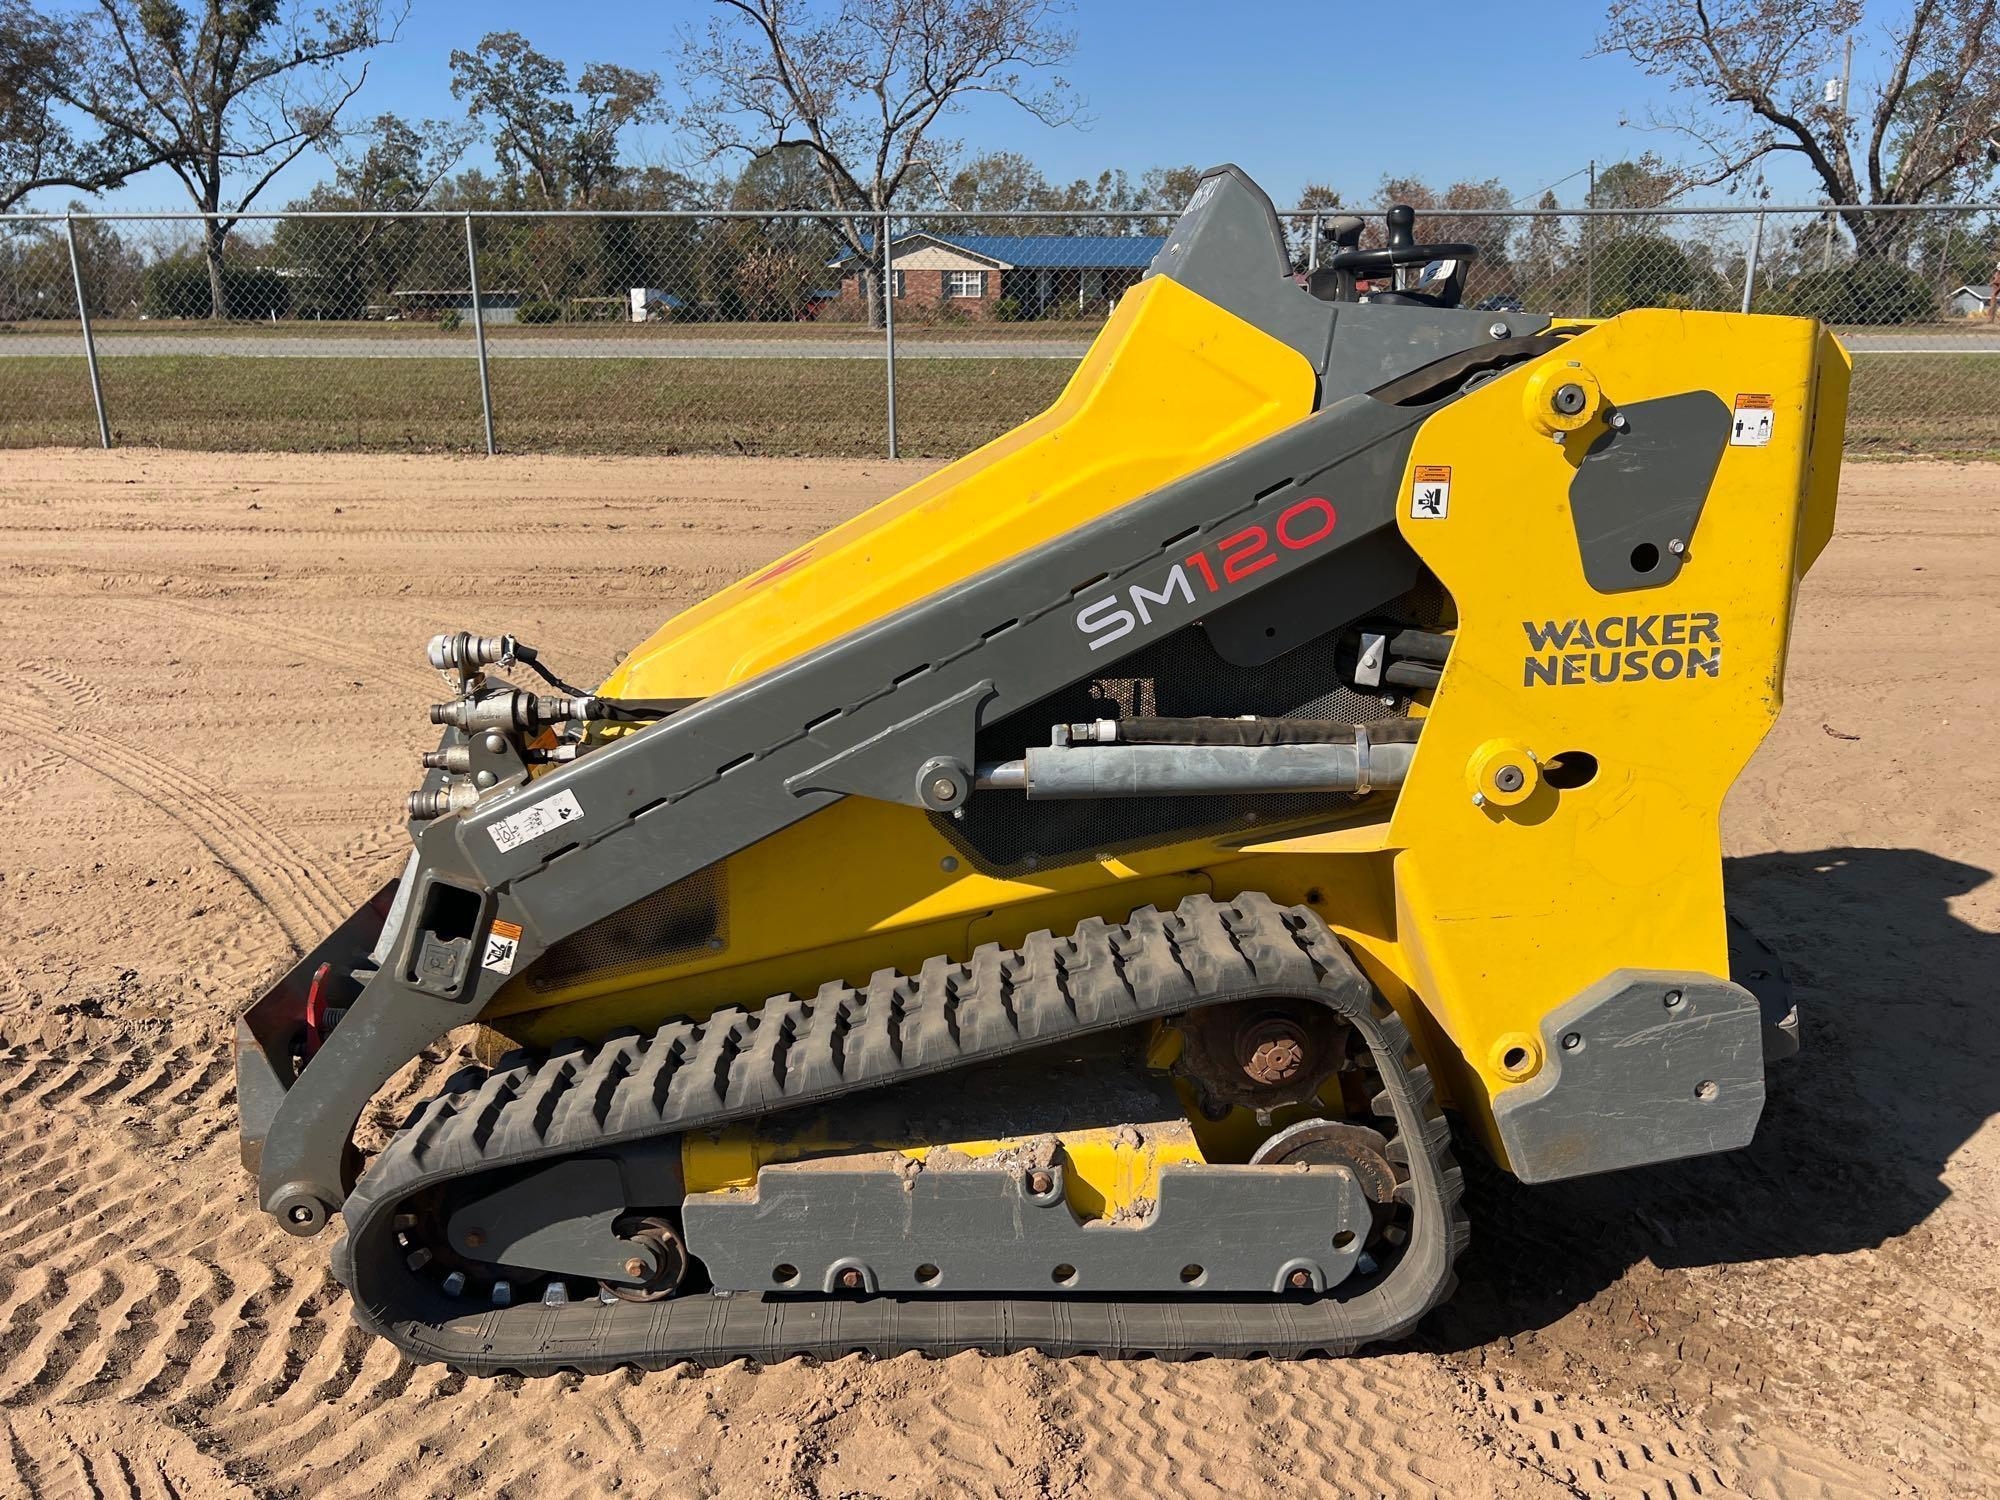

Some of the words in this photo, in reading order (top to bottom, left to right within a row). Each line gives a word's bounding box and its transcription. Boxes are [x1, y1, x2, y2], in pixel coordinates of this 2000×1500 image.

[1076, 497, 1337, 652] SM120
[1522, 612, 1721, 652] WACKER
[1523, 647, 1721, 687] NEUSON
